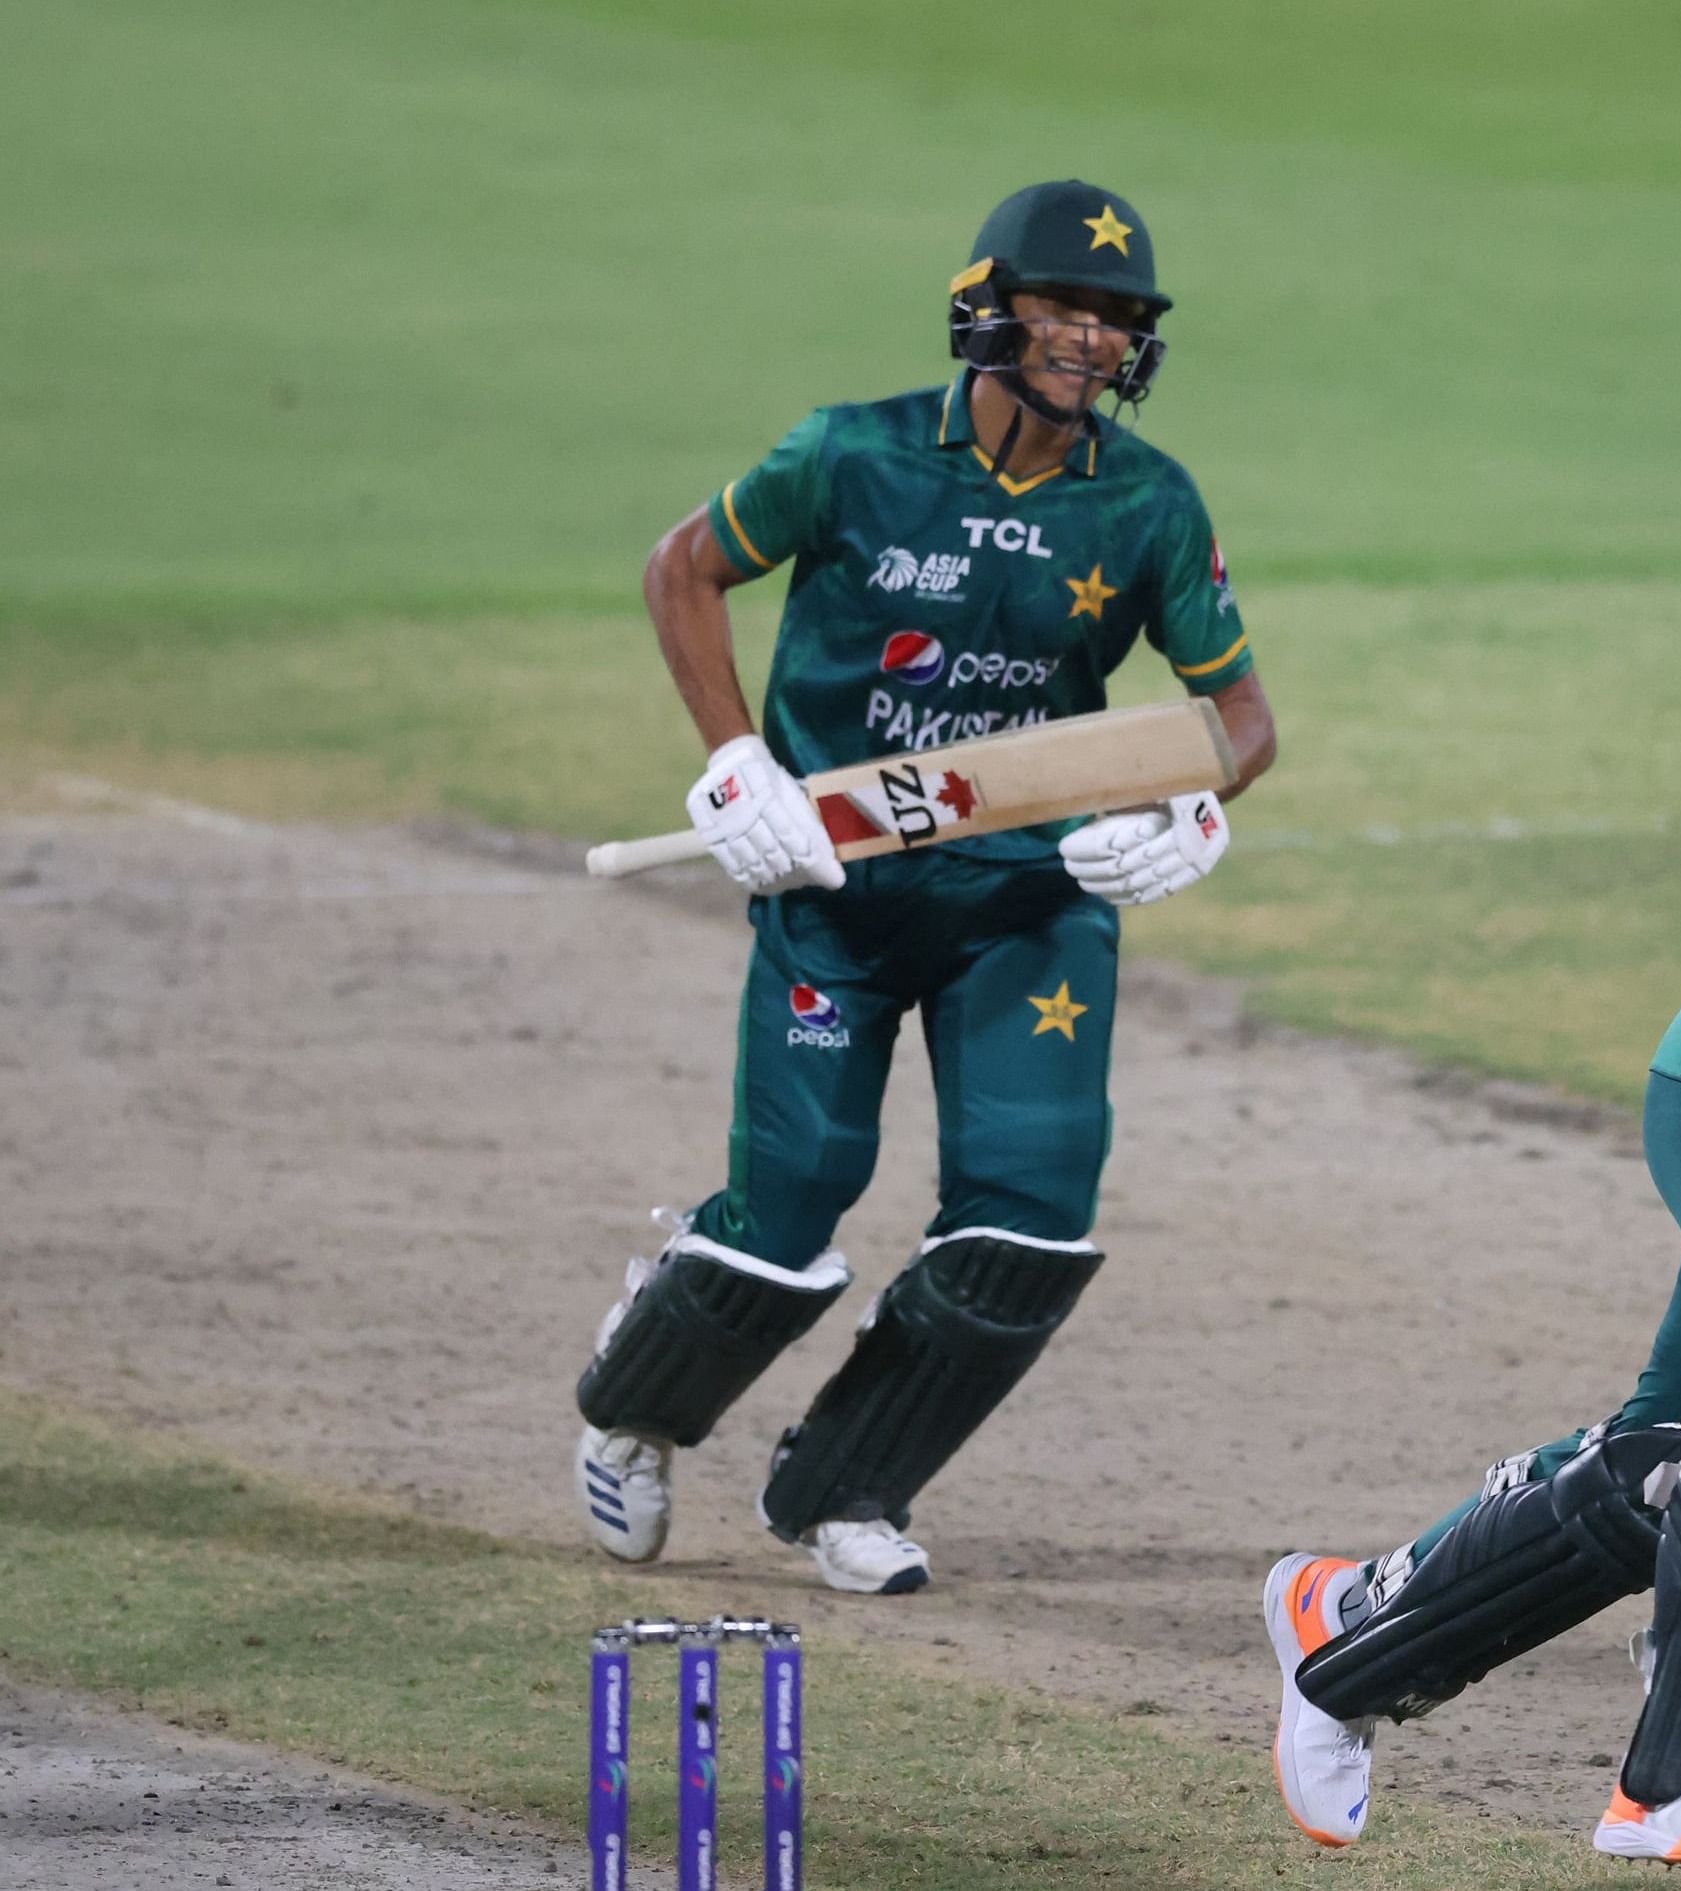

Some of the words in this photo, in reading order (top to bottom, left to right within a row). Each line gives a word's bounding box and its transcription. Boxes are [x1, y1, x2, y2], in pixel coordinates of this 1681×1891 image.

[961, 517, 1053, 559] TCL
[922, 553, 971, 576] ASIA
[916, 572, 960, 592] CUP
[879, 763, 937, 849] UZ
[787, 1027, 850, 1050] pepsi
[696, 1661, 711, 1706] ORLD
